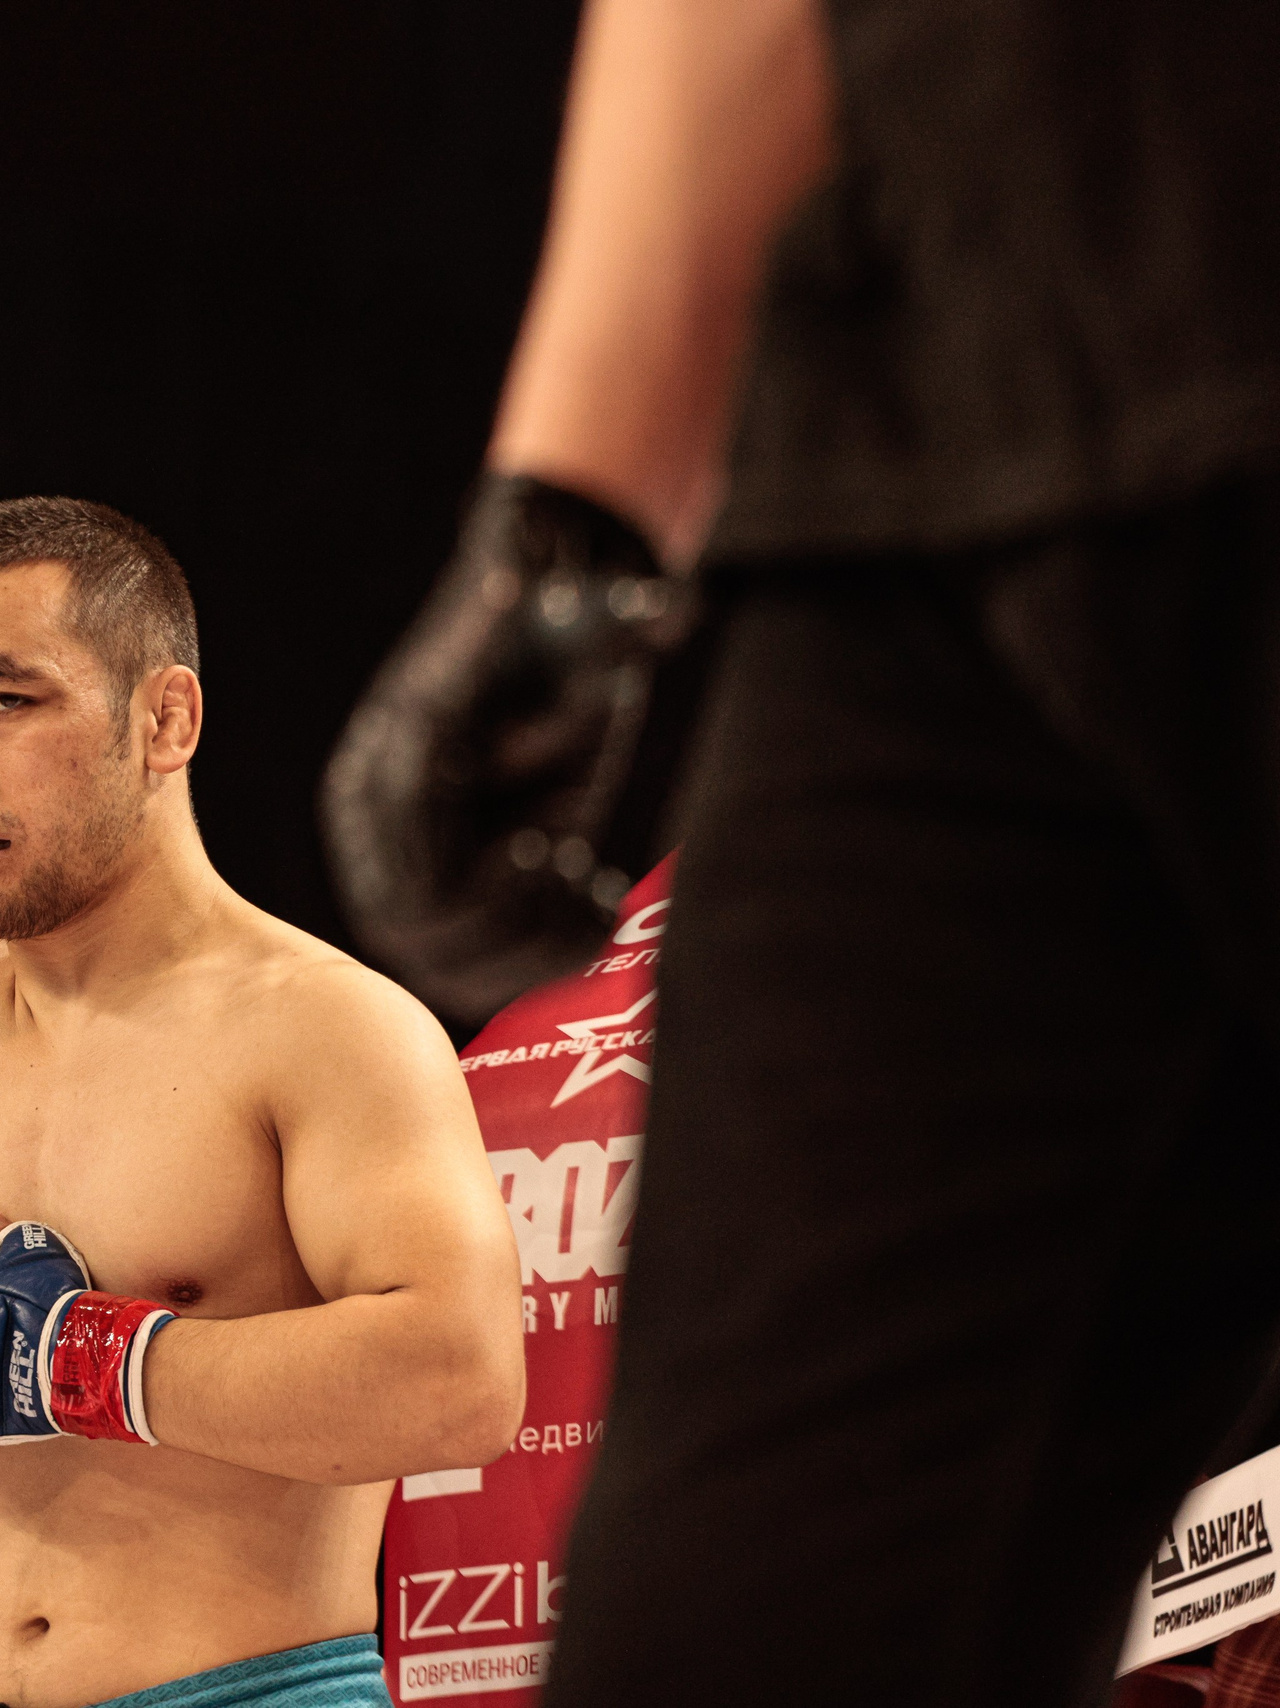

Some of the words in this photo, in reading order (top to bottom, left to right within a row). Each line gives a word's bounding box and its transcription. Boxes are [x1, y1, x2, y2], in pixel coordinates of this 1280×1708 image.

[18, 1349, 38, 1418] HILL
[1186, 1498, 1272, 1570] АВАНГАРД
[406, 1653, 540, 1689] СОВРЕМЕННОЕ
